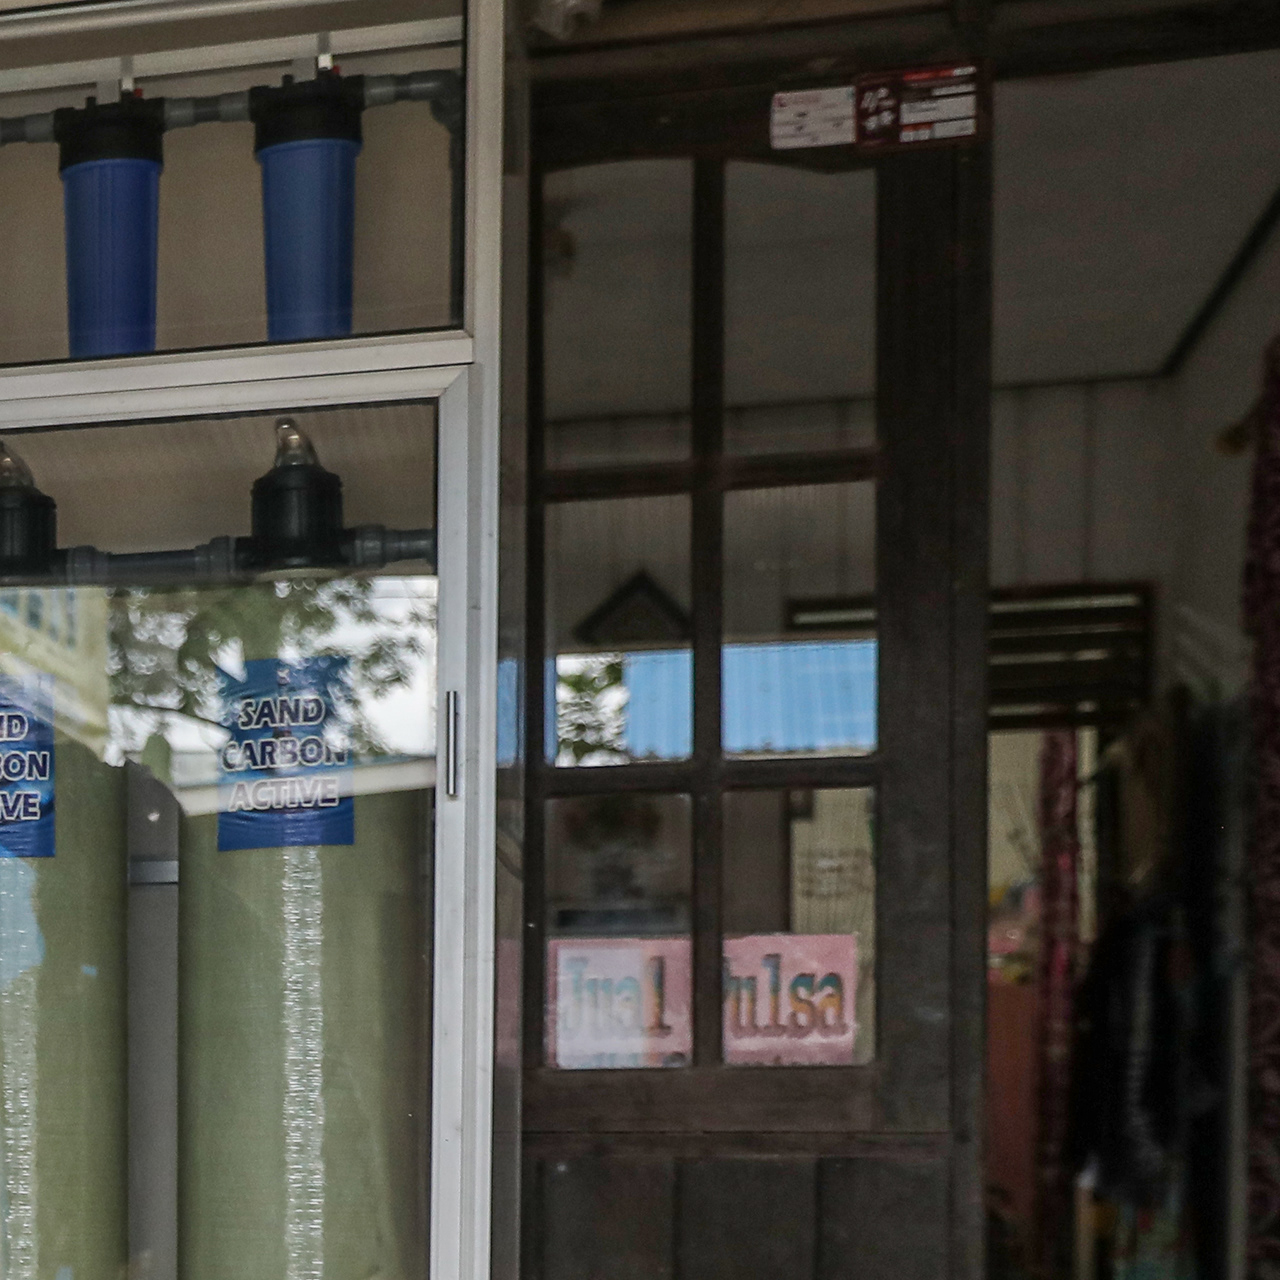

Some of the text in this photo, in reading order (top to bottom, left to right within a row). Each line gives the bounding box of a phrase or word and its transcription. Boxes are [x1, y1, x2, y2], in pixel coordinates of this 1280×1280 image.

[239, 697, 325, 730] SAND
[222, 735, 347, 772] CARBON
[228, 776, 339, 812] ACTIVE
[724, 953, 848, 1036] ulsa
